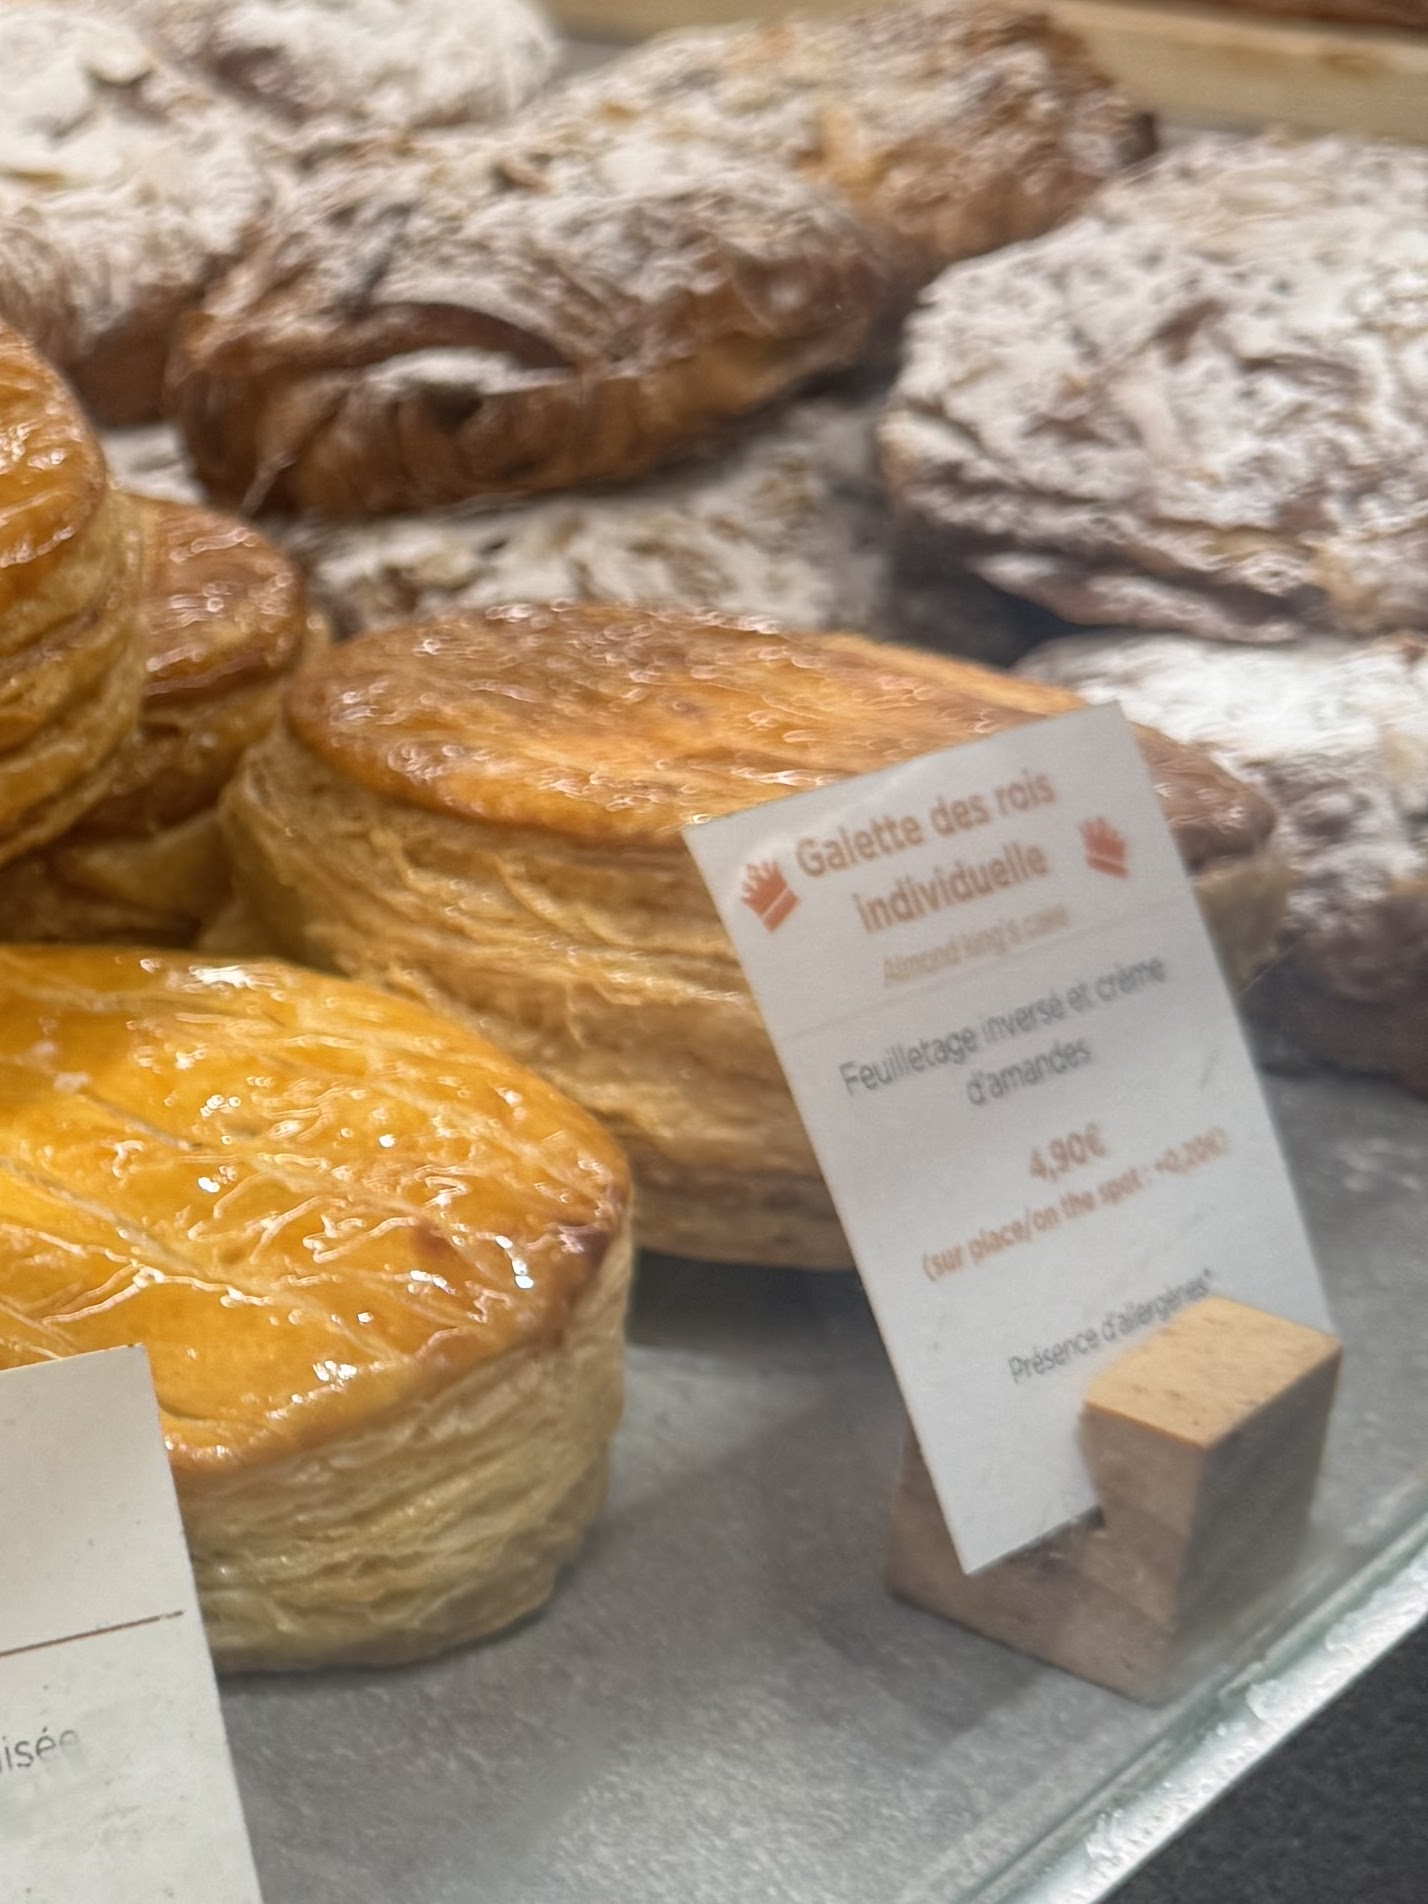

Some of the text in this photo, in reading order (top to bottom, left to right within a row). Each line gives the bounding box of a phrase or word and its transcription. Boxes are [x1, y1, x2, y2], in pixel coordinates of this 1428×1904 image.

[796, 768, 1058, 878] Galette des rois
[839, 1027, 978, 1096] Feuilletage
[1067, 982, 1094, 1013] et
[1009, 1327, 1100, 1384] Présence
